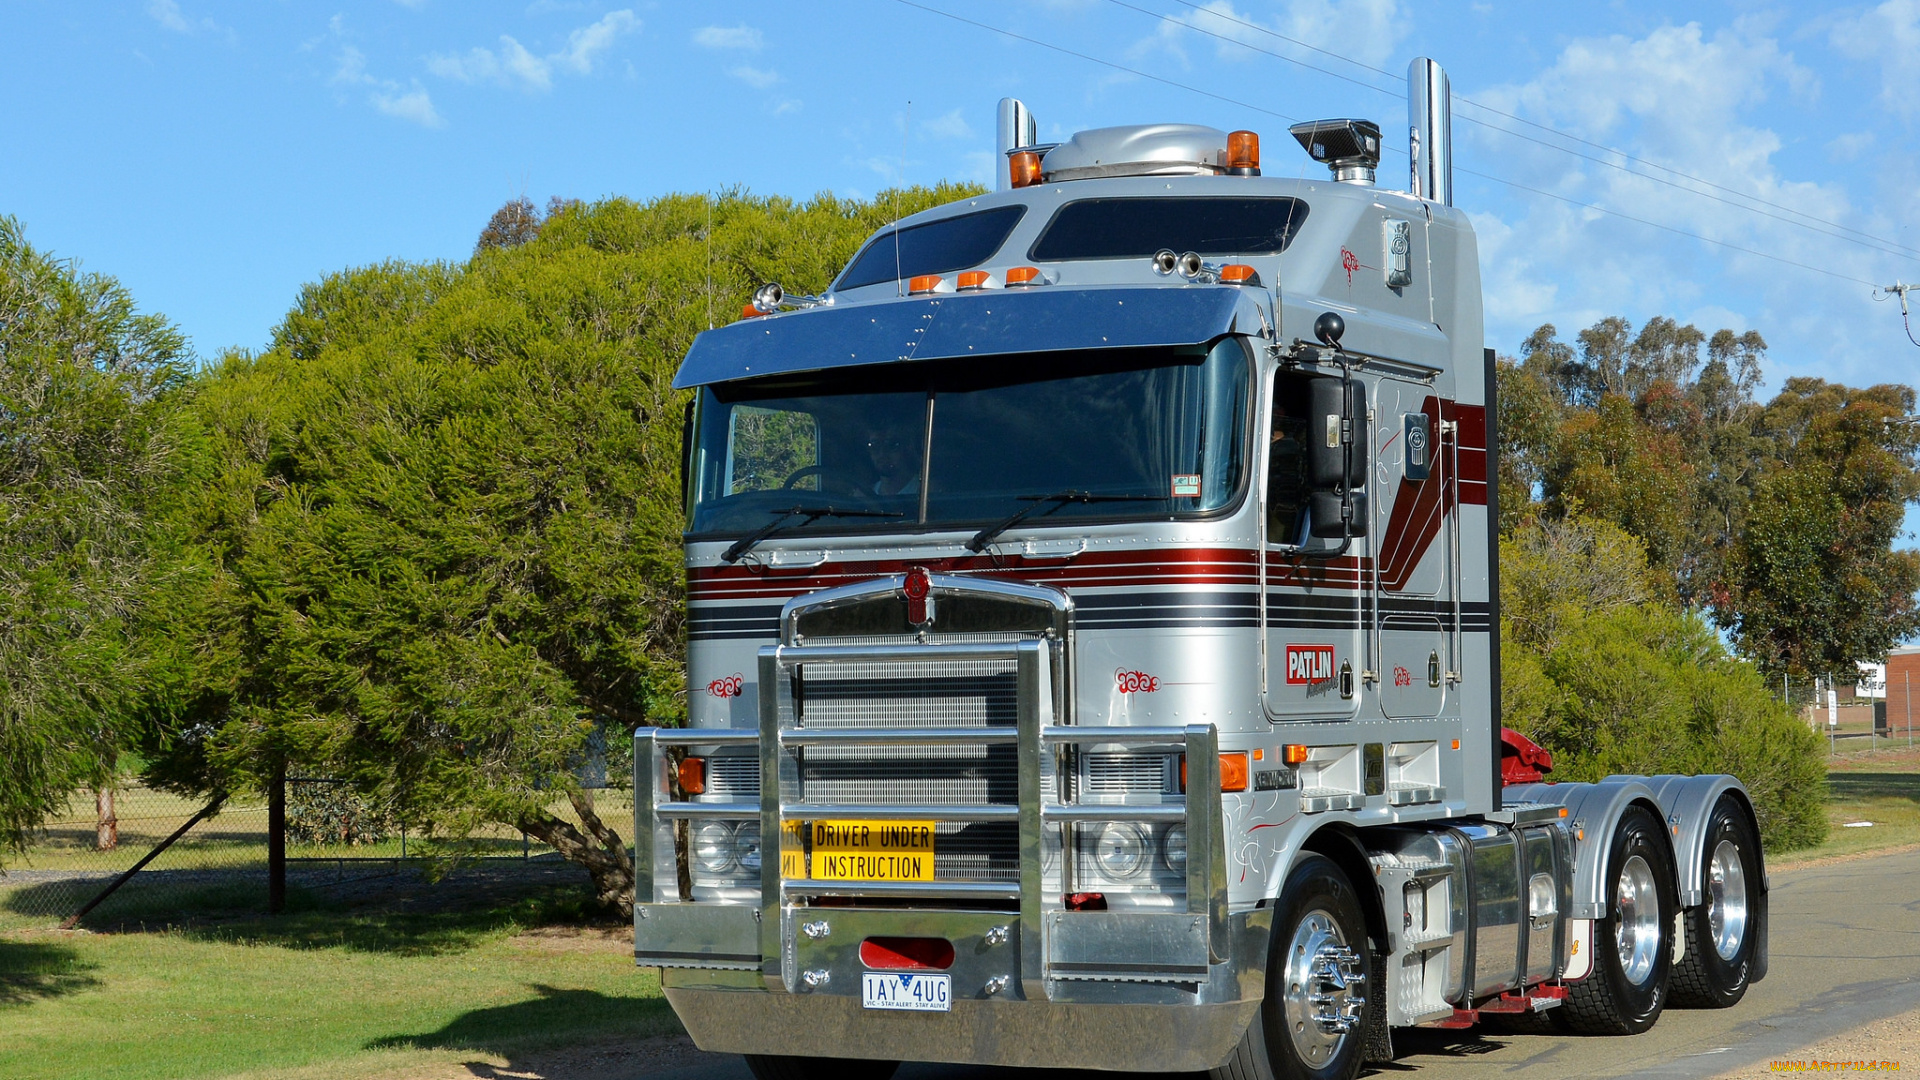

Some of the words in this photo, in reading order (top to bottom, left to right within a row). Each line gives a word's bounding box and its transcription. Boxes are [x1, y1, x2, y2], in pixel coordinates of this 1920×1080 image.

[1289, 651, 1332, 679] PATLIN
[1255, 770, 1297, 788] KENWORTH
[816, 825, 870, 847] DRIVER
[880, 826, 930, 848] UNDER
[824, 856, 922, 879] INSTRUCTION
[868, 979, 898, 1001] 1AY
[913, 980, 946, 1002] 4UG
